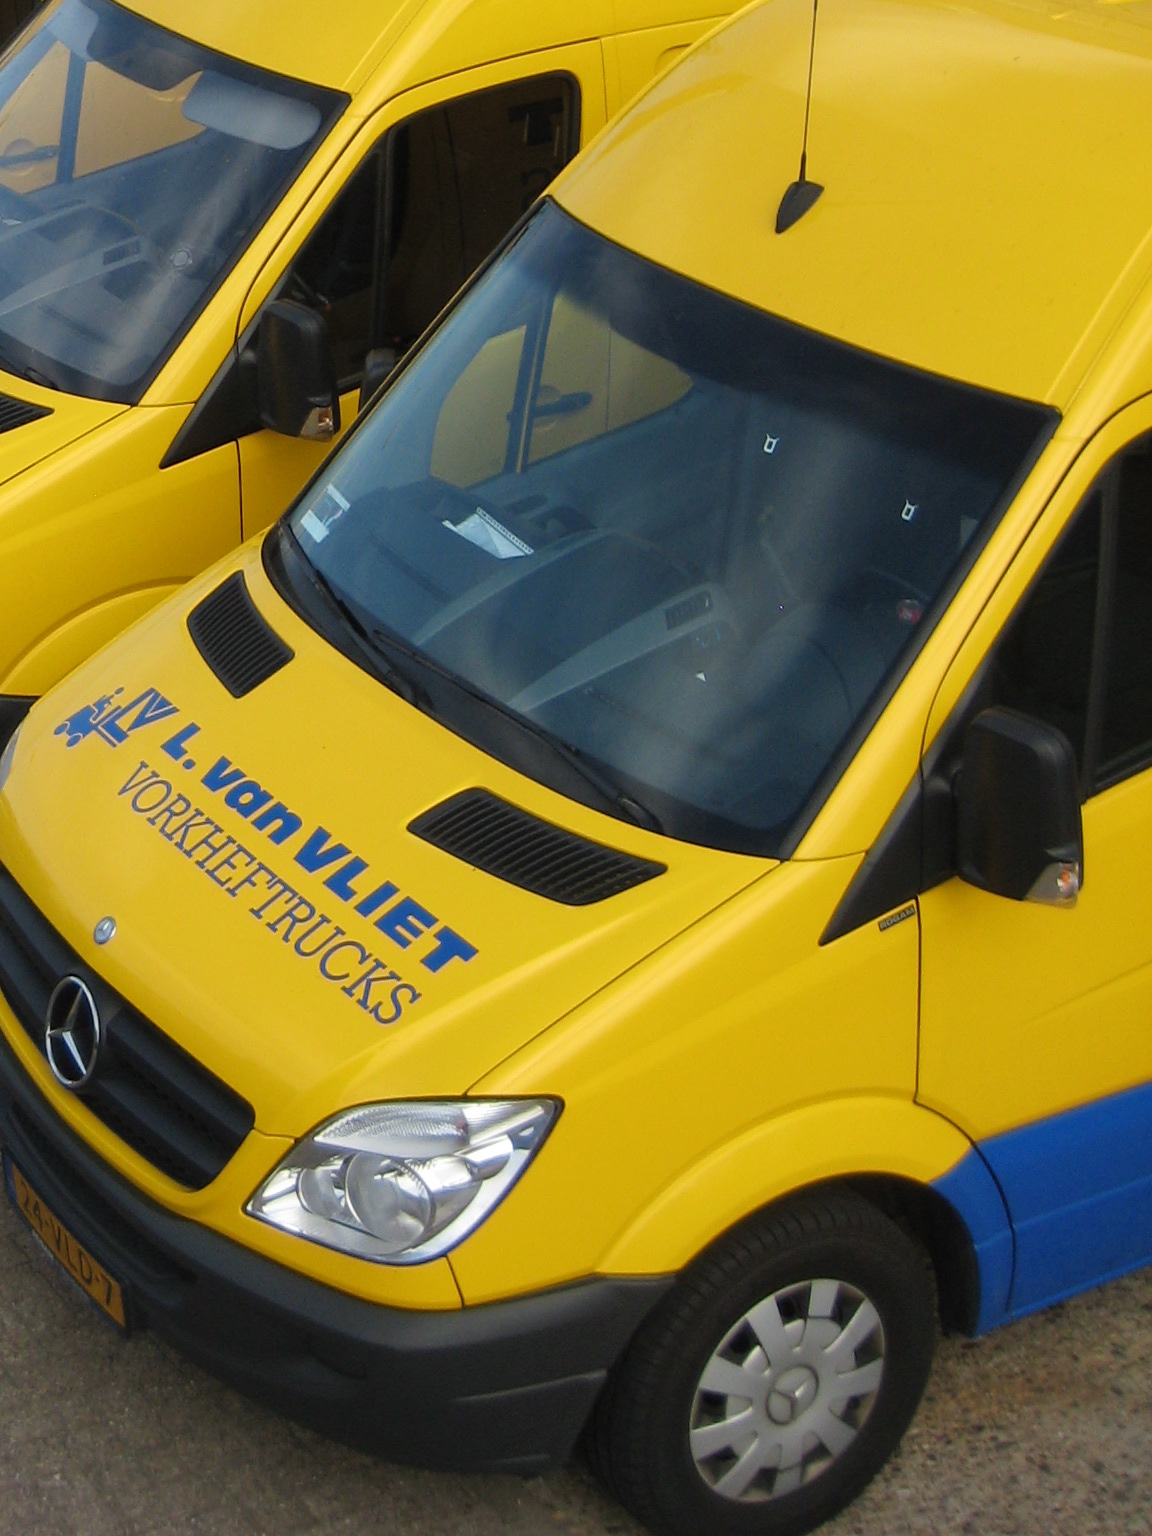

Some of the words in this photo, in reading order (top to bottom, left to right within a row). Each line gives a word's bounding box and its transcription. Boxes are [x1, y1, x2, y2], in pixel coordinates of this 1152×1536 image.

[118, 761, 422, 1025] VORKHEFTRUCKS
[160, 722, 202, 771] L.
[201, 755, 303, 846] van
[294, 826, 479, 973] VLIET
